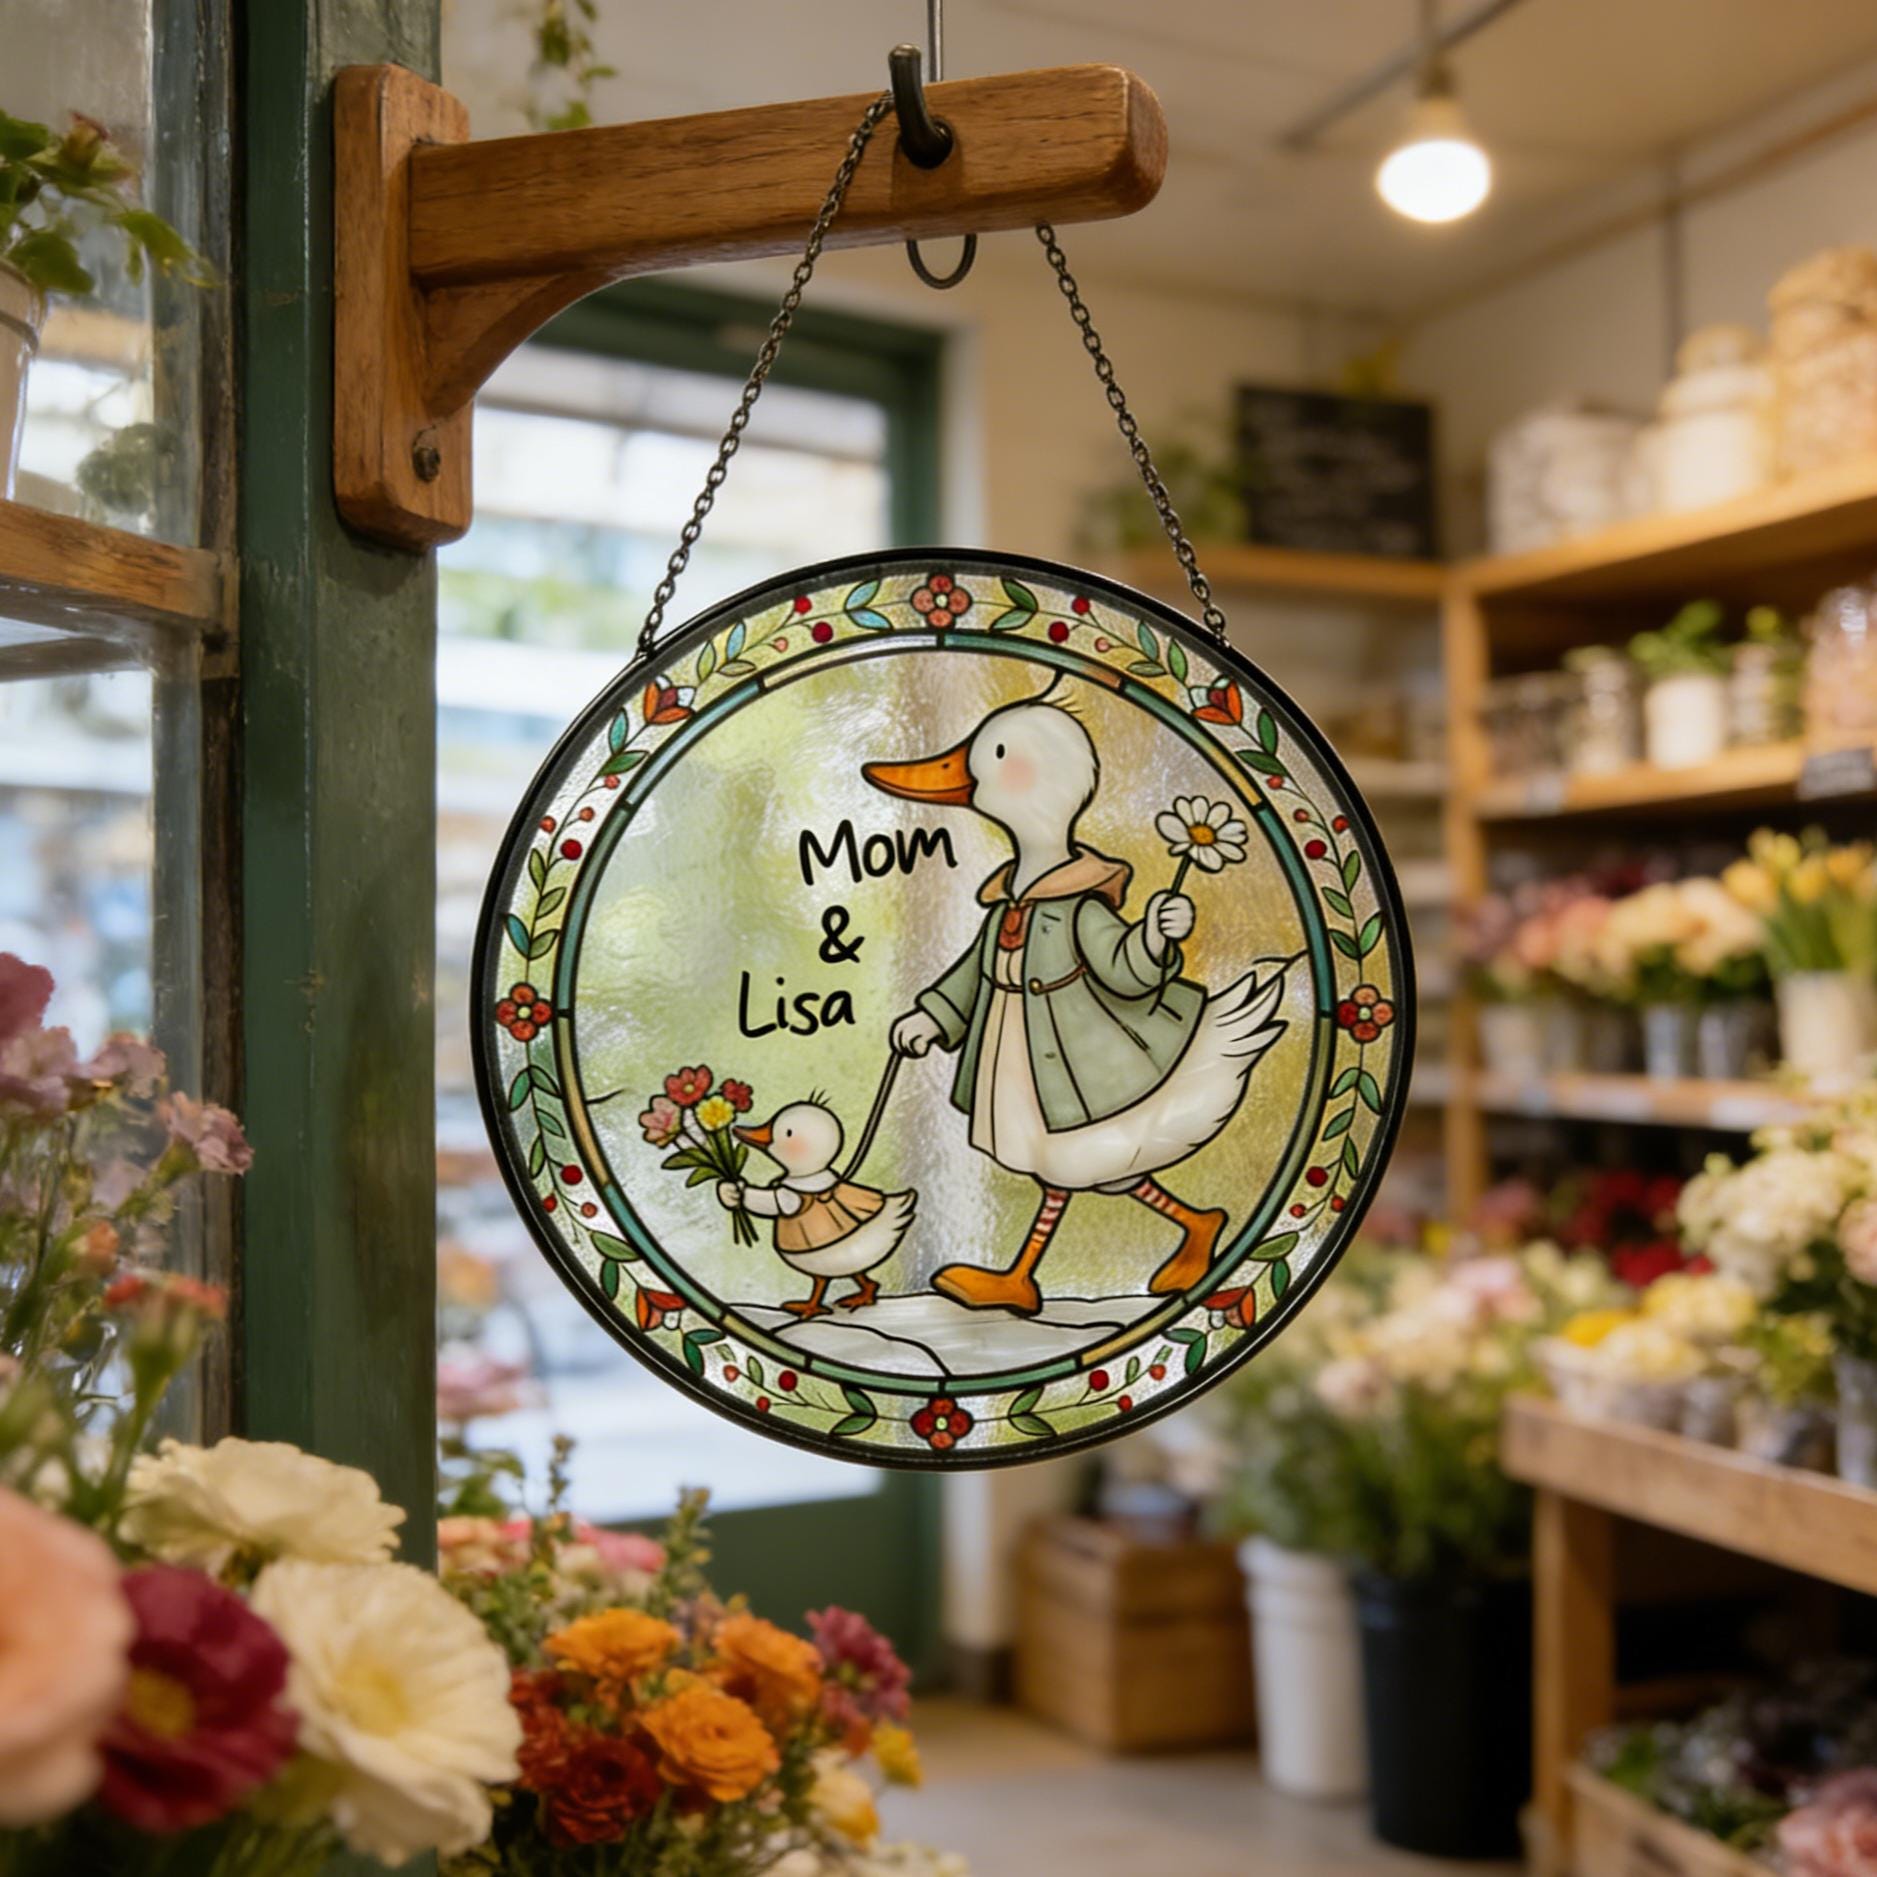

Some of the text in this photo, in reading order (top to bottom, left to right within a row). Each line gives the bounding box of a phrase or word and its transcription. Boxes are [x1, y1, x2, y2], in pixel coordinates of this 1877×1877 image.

[799, 819, 958, 886] Mom
[818, 905, 865, 964] &
[738, 970, 856, 1038] Lisa
